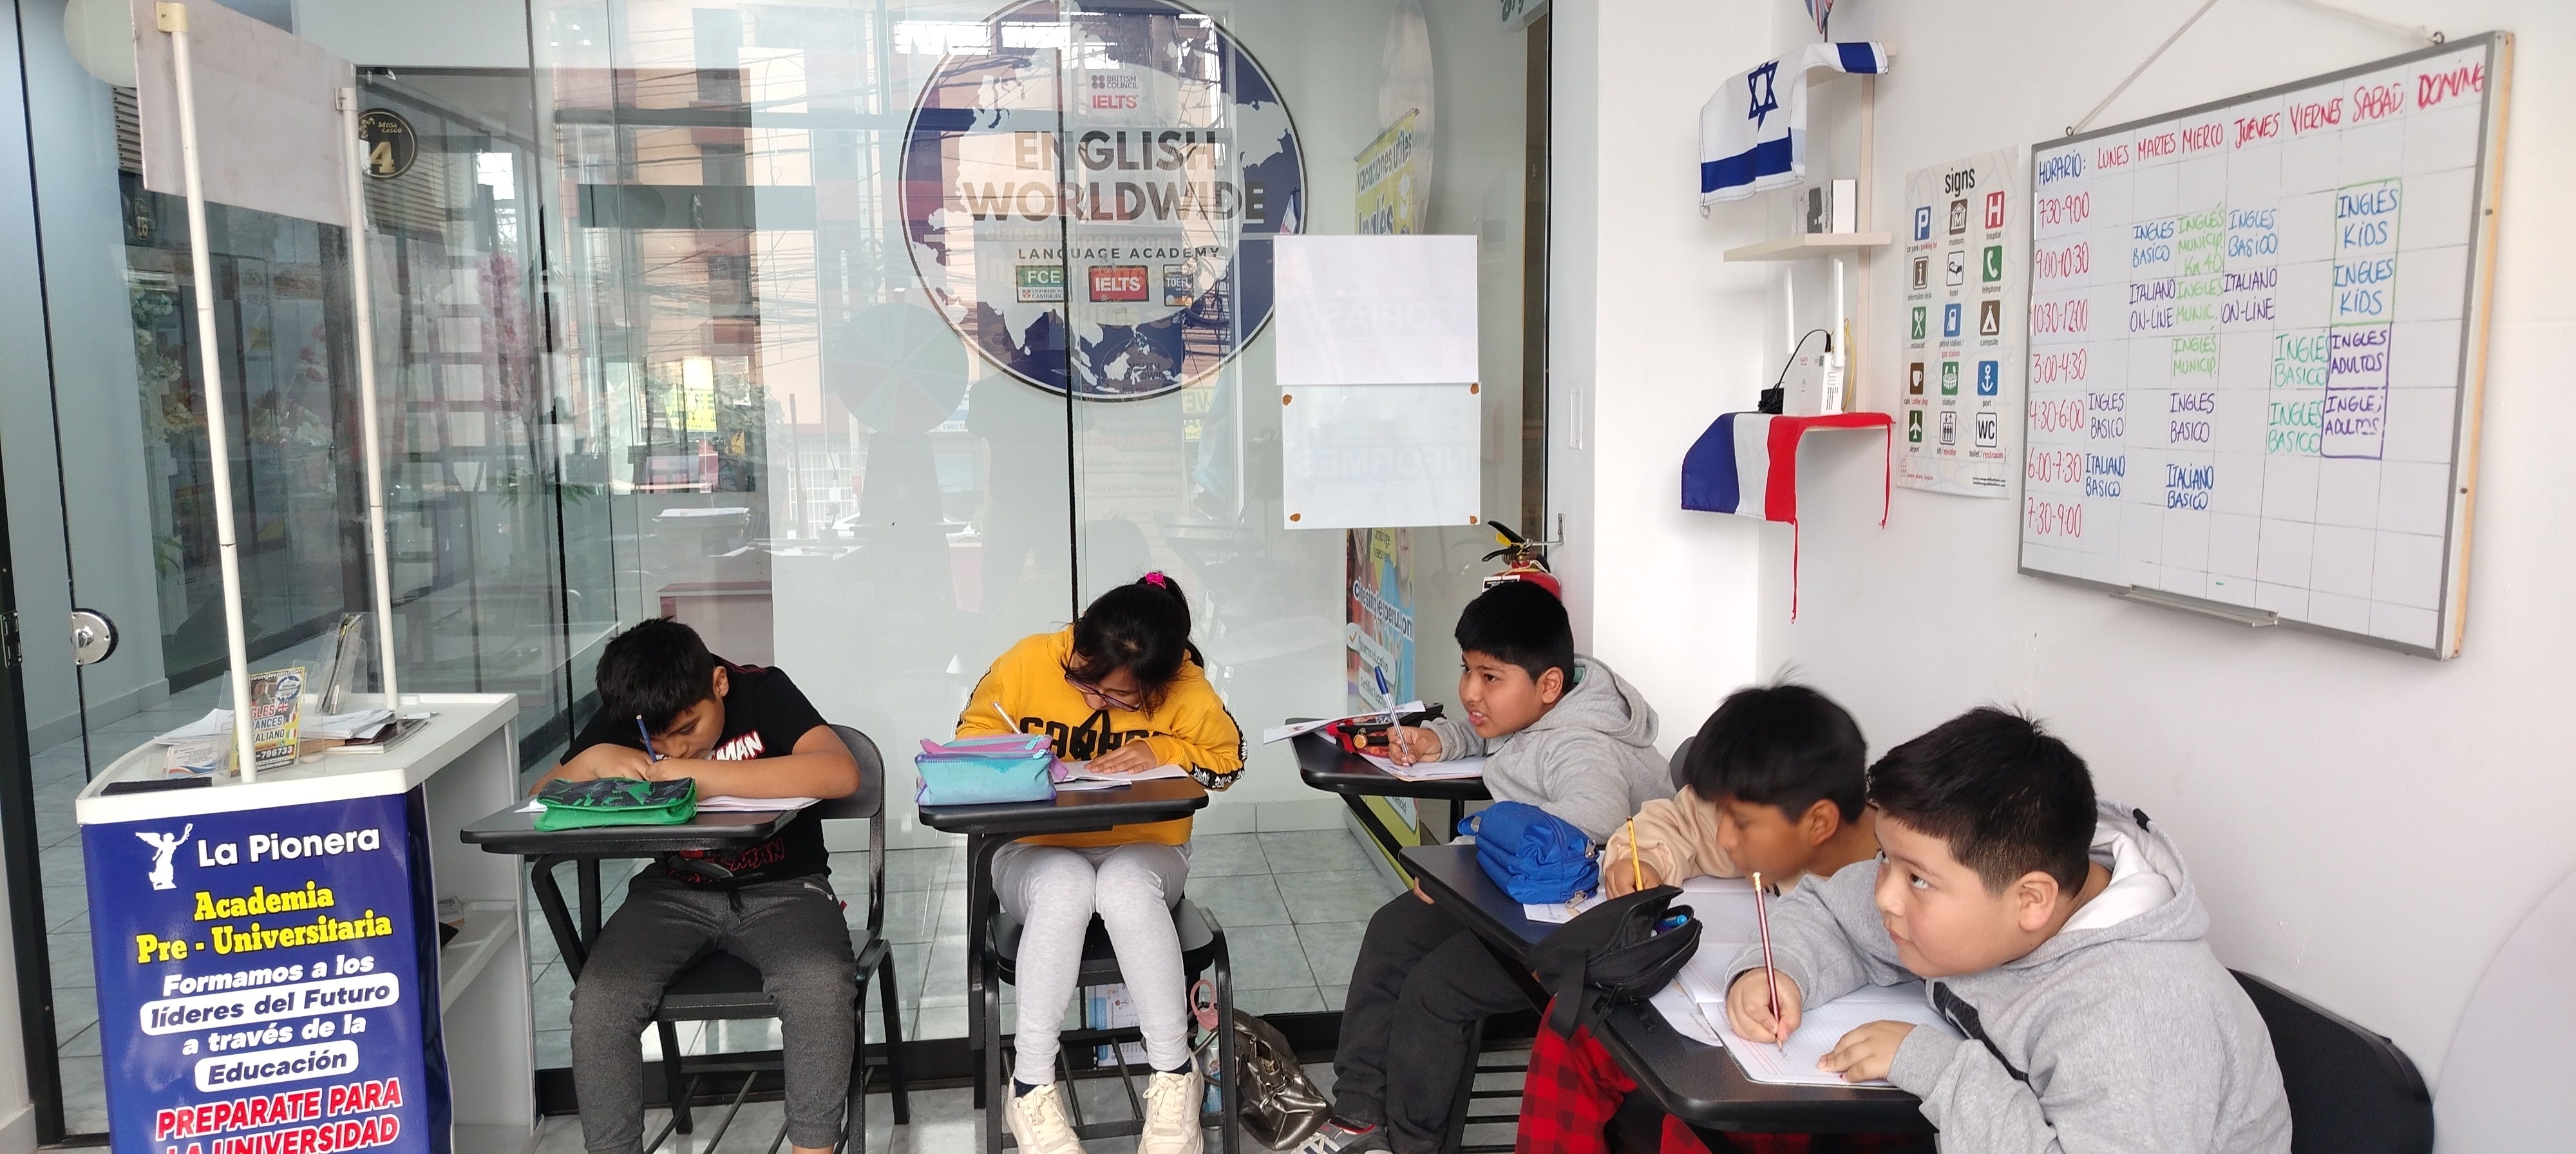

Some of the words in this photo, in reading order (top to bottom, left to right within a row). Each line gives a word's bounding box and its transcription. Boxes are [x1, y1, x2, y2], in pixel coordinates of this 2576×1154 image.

[1092, 95, 1138, 109] IELTS
[2097, 144, 2130, 170] LUNES
[2137, 132, 2177, 162] MARTES
[2181, 123, 2224, 155] MIERCO
[2233, 112, 2282, 149] JUEVES
[2290, 97, 2344, 136] VIERNES
[370, 141, 395, 173] 4
[1014, 130, 1217, 171] ENGLISH
[1945, 167, 1975, 197] signs
[962, 181, 1267, 222] WORLDWIDE
[1987, 194, 2002, 226] H
[1917, 209, 1928, 239] P
[2133, 221, 2175, 241] INGLES
[2228, 208, 2277, 231] INGLES
[1949, 238, 1964, 246] museum
[1986, 230, 2002, 240] hospital
[1128, 248, 1220, 258] ACADEMY
[1027, 270, 1061, 284] FCE
[1095, 276, 1142, 292] IELTS
[2223, 267, 2278, 293] ITALIANO
[2333, 258, 2394, 287] INGLES
[1982, 285, 2002, 295] telephone
[2129, 278, 2176, 306] ITALIANO
[1980, 338, 1999, 347] campsite
[2331, 330, 2388, 350] INGLES
[2331, 352, 2385, 374] ADULTOS
[2274, 363, 2329, 388] BASICO
[1982, 399, 1992, 408] port
[2088, 392, 2125, 411] INGLES
[2170, 392, 2215, 415] INGLES
[2269, 400, 2324, 428] INGLES
[1978, 420, 1995, 440] WC
[2090, 417, 2125, 440] BASICO
[2170, 420, 2210, 444] BASICO
[2268, 428, 2322, 453] BASICO
[1969, 449, 1980, 458] toilet
[1982, 450, 2003, 460] restroom
[2085, 453, 2126, 478] ITALIANO
[2085, 475, 2121, 498] BASICO
[2166, 462, 2214, 491] ITALIANO
[2167, 490, 2209, 510] BASICO
[252, 705, 276, 719] GLES
[253, 717, 283, 730] ANCES
[254, 728, 285, 742] ALIANO
[198, 839, 238, 867] La
[249, 828, 381, 863] Pionera
[194, 880, 334, 921] Academia
[135, 933, 188, 963] Pre
[195, 941, 205, 951] -
[211, 909, 392, 956] Universitaria
[162, 963, 303, 997] Formamos
[312, 961, 328, 978] a
[335, 954, 375, 975] los
[151, 1000, 245, 1029] líderes
[254, 991, 296, 1015] del
[303, 984, 391, 1010] Futuro
[182, 1039, 199, 1055] a
[207, 1024, 293, 1052] través
[301, 1017, 336, 1039] de
[343, 1016, 366, 1035] la
[207, 1050, 348, 1086] Educación
[156, 1088, 323, 1141] PREPARATE
[328, 1077, 403, 1117] PARA
[211, 1114, 401, 1154] UNIVERSIDAD
